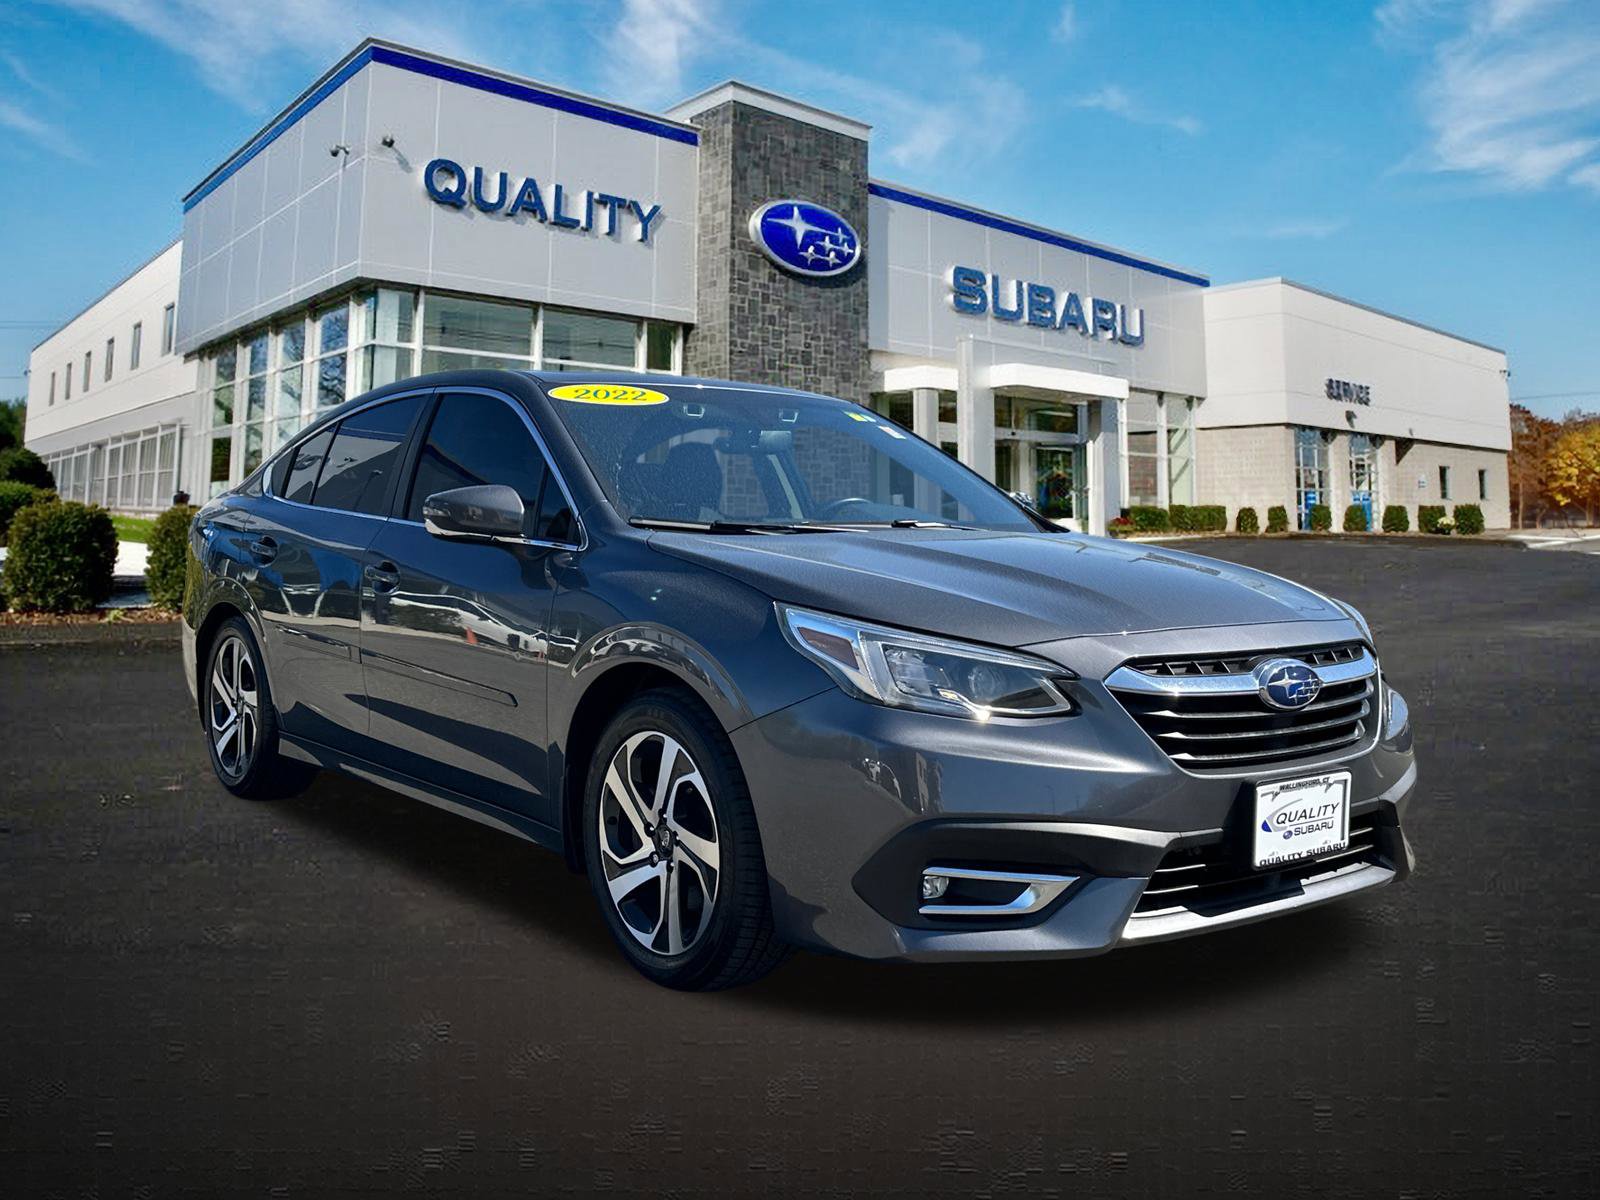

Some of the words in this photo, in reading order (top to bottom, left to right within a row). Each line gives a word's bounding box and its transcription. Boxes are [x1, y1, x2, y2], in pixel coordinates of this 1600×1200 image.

[425, 158, 661, 242] QUALITY
[952, 266, 1144, 346] SUBARU
[574, 388, 647, 401] 2022
[1276, 802, 1339, 824] QUALITY
[1294, 820, 1334, 836] SUBARU
[1259, 851, 1302, 866] QUALITY
[1306, 842, 1346, 857] SUBARU
